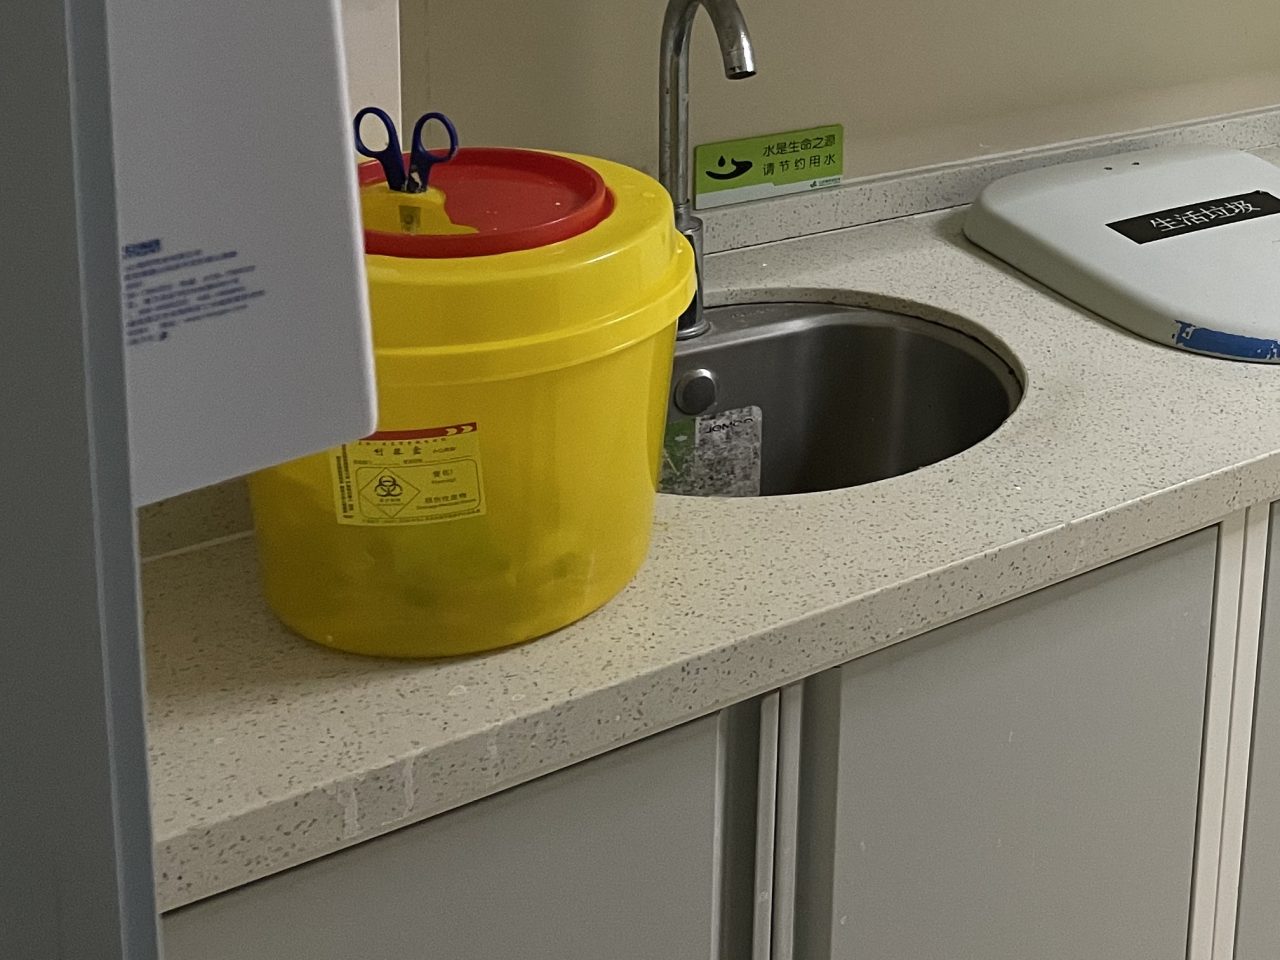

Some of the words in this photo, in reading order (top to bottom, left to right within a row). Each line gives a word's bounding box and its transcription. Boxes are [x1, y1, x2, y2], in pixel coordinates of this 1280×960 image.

[762, 134, 836, 157] 水是生命之源
[762, 153, 836, 177] 请节约用水
[1150, 200, 1261, 232] 生活垃圾
